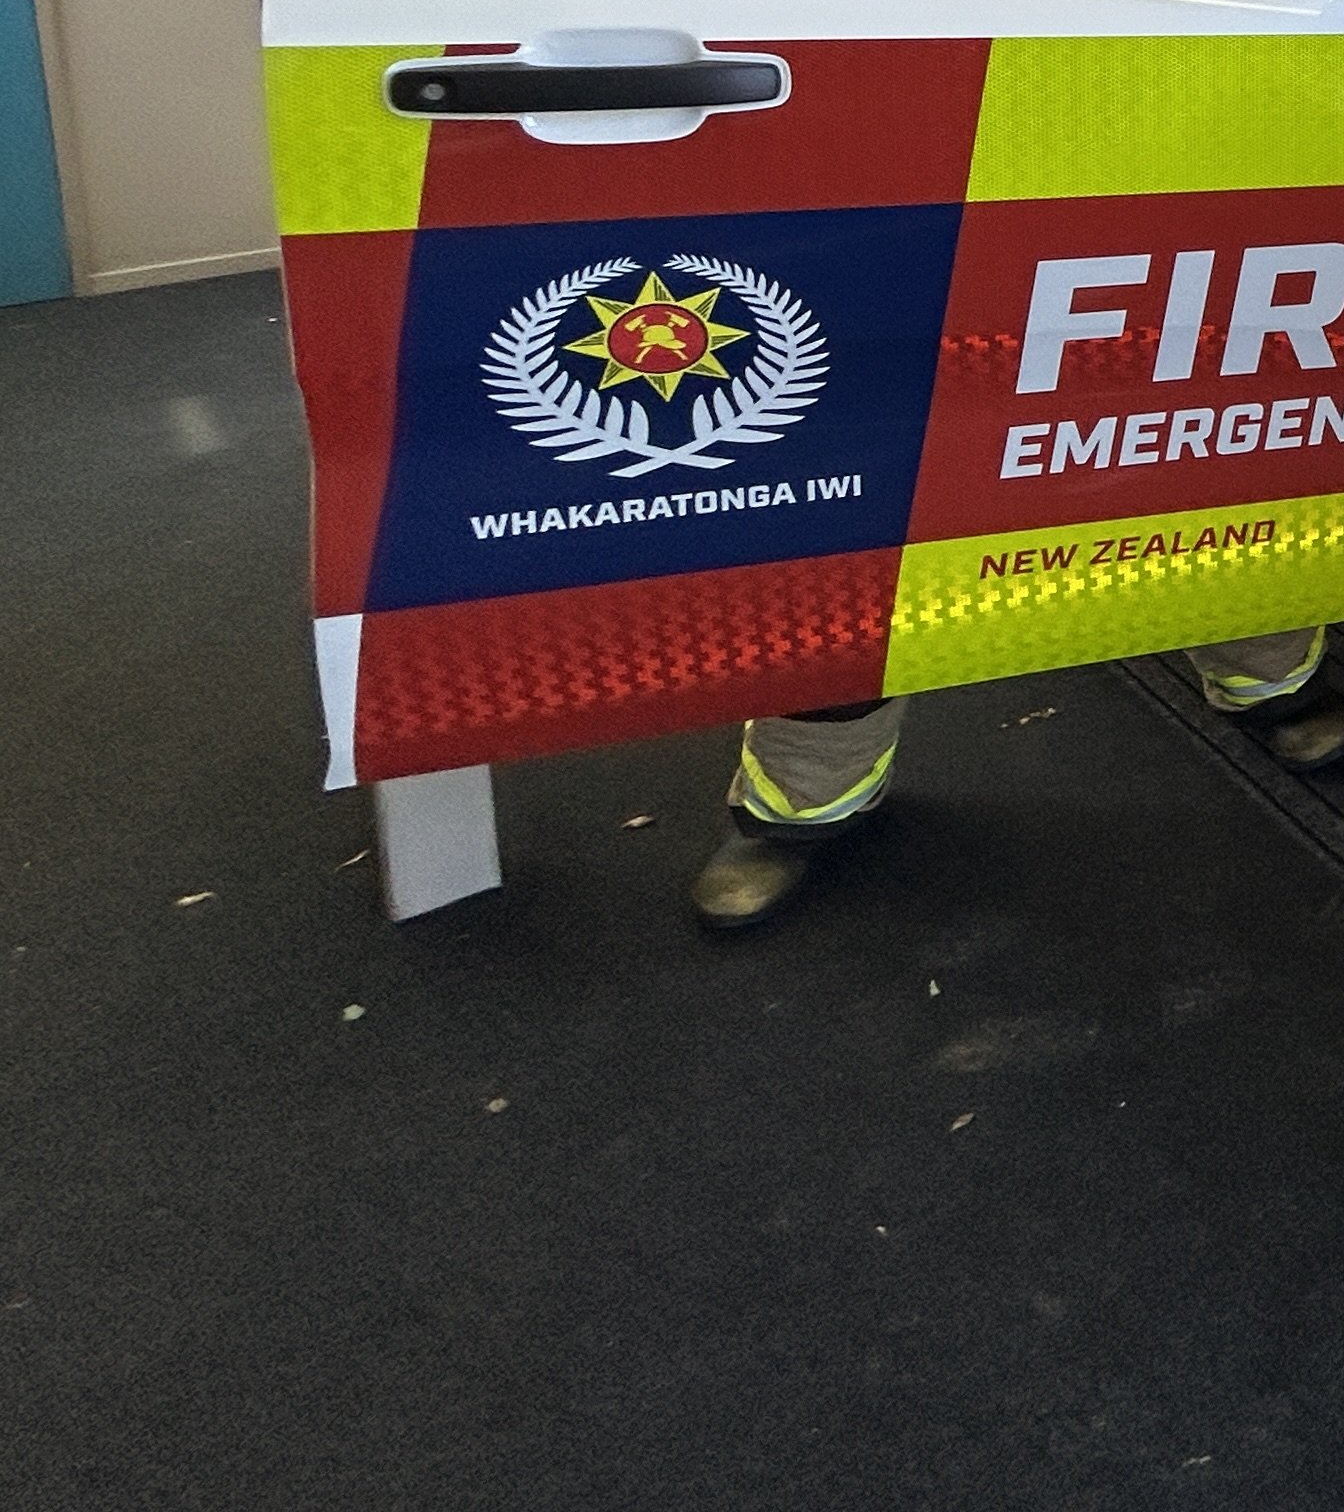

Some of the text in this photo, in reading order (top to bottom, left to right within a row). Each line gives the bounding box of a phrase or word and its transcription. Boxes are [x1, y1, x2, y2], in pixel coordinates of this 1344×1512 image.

[470, 474, 862, 540] WHAKARATONGA IWI
[979, 520, 1277, 580] NEW ZEALAND
